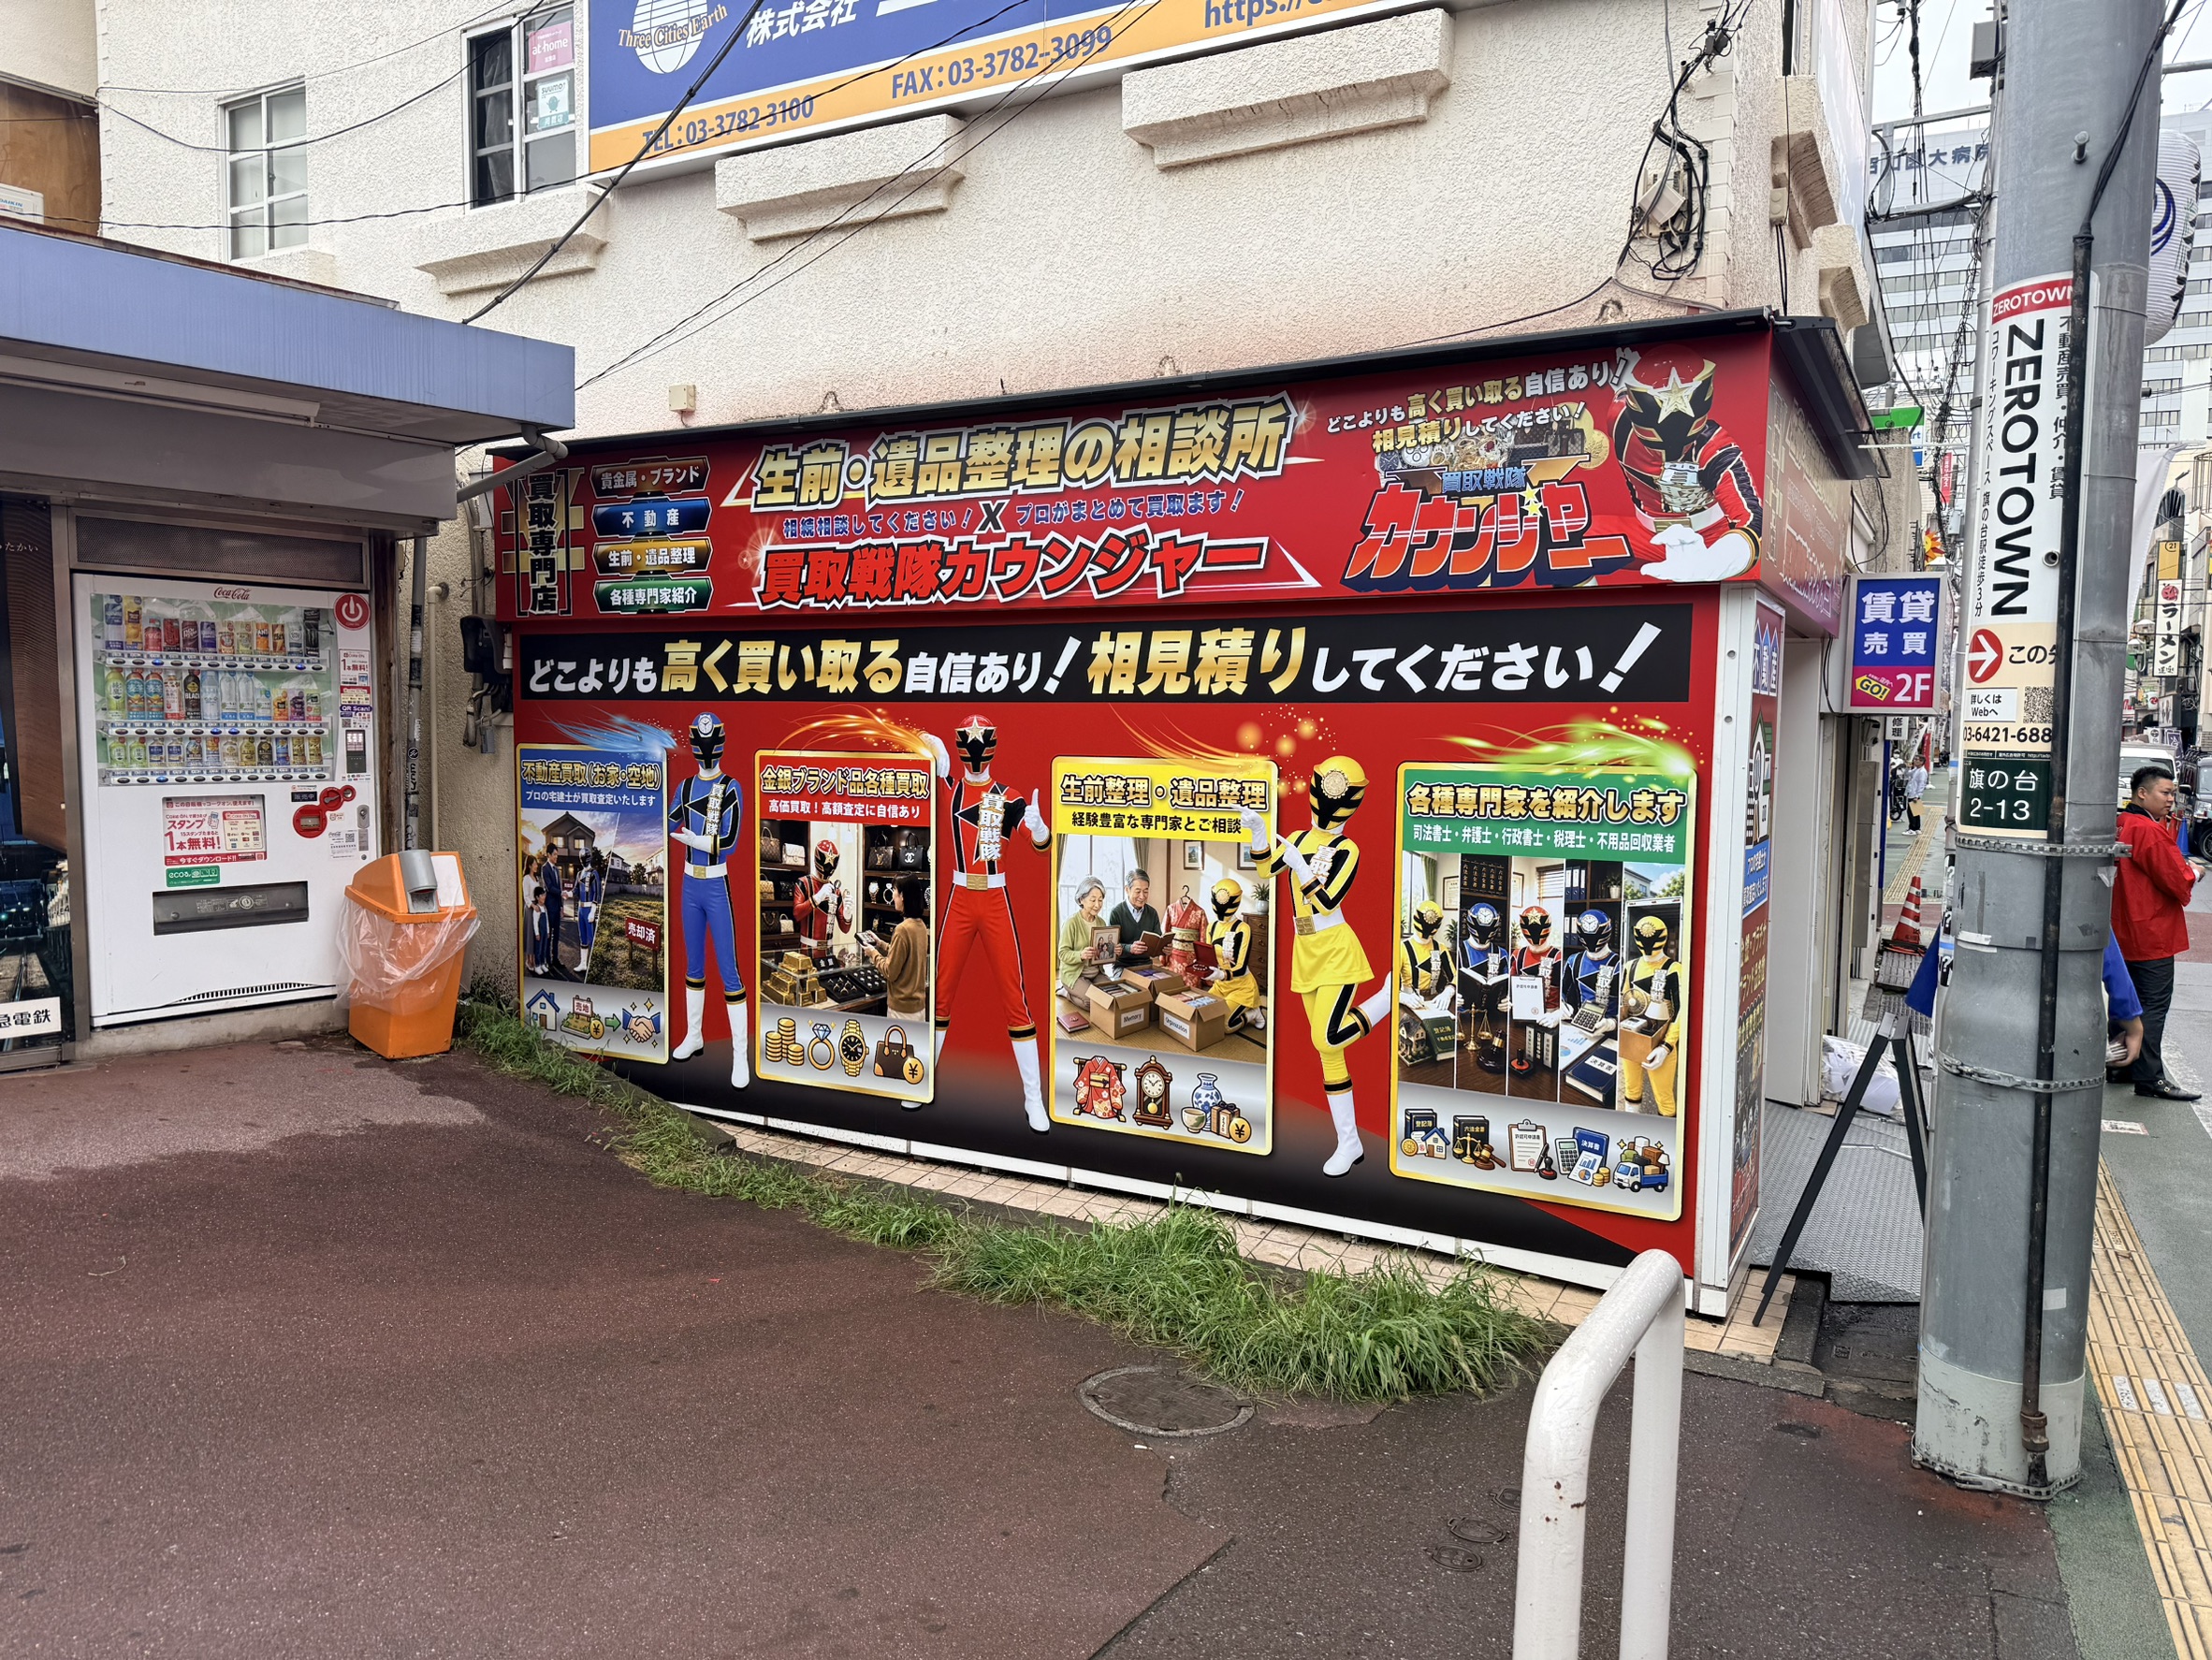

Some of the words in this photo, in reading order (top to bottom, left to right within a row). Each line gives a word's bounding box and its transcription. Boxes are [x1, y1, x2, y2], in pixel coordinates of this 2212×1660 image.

[618, 28, 651, 48] Three
[654, 22, 689, 46] Cities
[691, 4, 728, 36] Earth
[745, 0, 860, 48] 株式会社
[1372, 401, 1587, 454] 相見積りしてください！
[752, 397, 1293, 510] 生前・遺品整理の相談所
[1990, 318, 2045, 617] ZEROTOWN
[601, 466, 700, 489] 貴金属・ブランド
[1441, 467, 1527, 494] 買取戦隊
[621, 508, 679, 529] 不動産
[1015, 488, 1244, 526] プロがまとめて買取ます！
[527, 473, 560, 615] 買取専門店
[1345, 482, 1632, 580] カウンジャー
[608, 546, 696, 567] 生前・遺品整理
[758, 529, 1265, 605] 買取戦隊カウンジャー
[610, 587, 697, 606] 各種専門家紹介
[1861, 590, 1935, 624] 賃貸
[1864, 632, 1928, 656] 売買
[2159, 603, 2178, 664] ラーメン
[1859, 678, 1888, 699] GO!
[1894, 673, 1931, 702] 2F
[1971, 693, 2002, 705] 詳しくは
[1972, 706, 1999, 718] Webへ
[1891, 718, 1903, 737] 修理
[761, 767, 930, 798] 金銀ブランド品各種買取
[1059, 774, 1269, 811] 生前整理・遺品整理
[1969, 767, 2039, 792] 旗の台
[1405, 782, 1688, 825] 各種専門家を紹介します
[1970, 797, 2030, 821] 2-13
[167, 818, 206, 830] スタンプ
[1071, 811, 1242, 835] 経験豊富な専門家とご相談
[628, 922, 656, 945] 売却済
